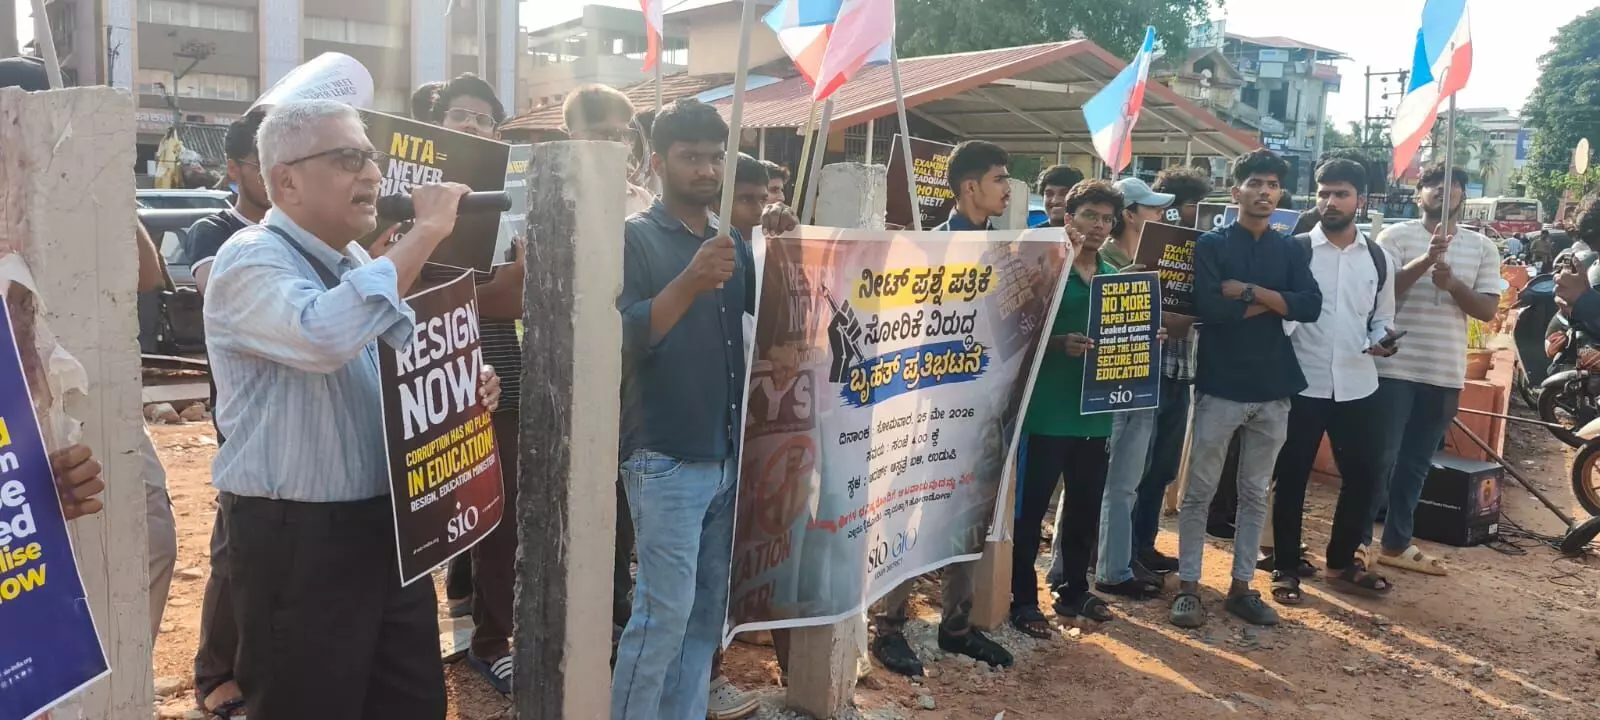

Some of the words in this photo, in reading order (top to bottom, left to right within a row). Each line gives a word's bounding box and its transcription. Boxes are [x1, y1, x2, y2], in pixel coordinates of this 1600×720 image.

[386, 158, 444, 185] NEVER
[1163, 252, 1184, 262] HALL
[1159, 269, 1185, 281] WHO
[859, 268, 910, 298] ನೀಟ್
[912, 265, 945, 305] ಪ್ರಶ್ನೆ
[948, 265, 992, 302] ಪತ್ರಿಕೆ
[1101, 282, 1129, 295] SCRAP
[1102, 296, 1117, 313] NO
[1120, 294, 1151, 312] MORE
[1162, 294, 1179, 305] sio
[1101, 314, 1125, 325] PAPER
[1126, 311, 1151, 323] LEAKS!
[395, 299, 480, 376] RESIGN
[864, 309, 924, 345] ಸೋರಿಕೆ
[926, 309, 977, 347] ವಿರುದ್ಧ
[1100, 324, 1127, 335] Leaked
[1128, 324, 1151, 333] exams
[1098, 344, 1116, 354] STOP
[1117, 343, 1129, 353] THE
[1131, 341, 1150, 351] LEAKS
[1099, 336, 1116, 345] steal
[1117, 335, 1129, 343] our
[1097, 354, 1132, 367] SECURE
[1133, 351, 1150, 364] OUR
[850, 354, 901, 403] ಬೃಹತ್
[903, 344, 982, 388] ಪ್ರತಿಭಟನೆ
[1096, 365, 1150, 381] EDUCATION
[1109, 384, 1133, 404] sio
[839, 426, 870, 445] ದಿನಾಂಕ
[917, 413, 927, 424] 25
[930, 408, 945, 421] ಮೇ
[949, 408, 974, 419] 2026
[406, 432, 451, 467] CORRUPTION
[450, 424, 468, 442] HAS
[464, 420, 474, 435] NO
[408, 470, 425, 497] IN
[427, 427, 495, 488] EDUCATION!
[928, 448, 957, 462] ಉಡುಪಿ
[411, 490, 439, 512] RESIGN,
[439, 470, 472, 497] EDUCATION
[447, 501, 479, 543] sio
